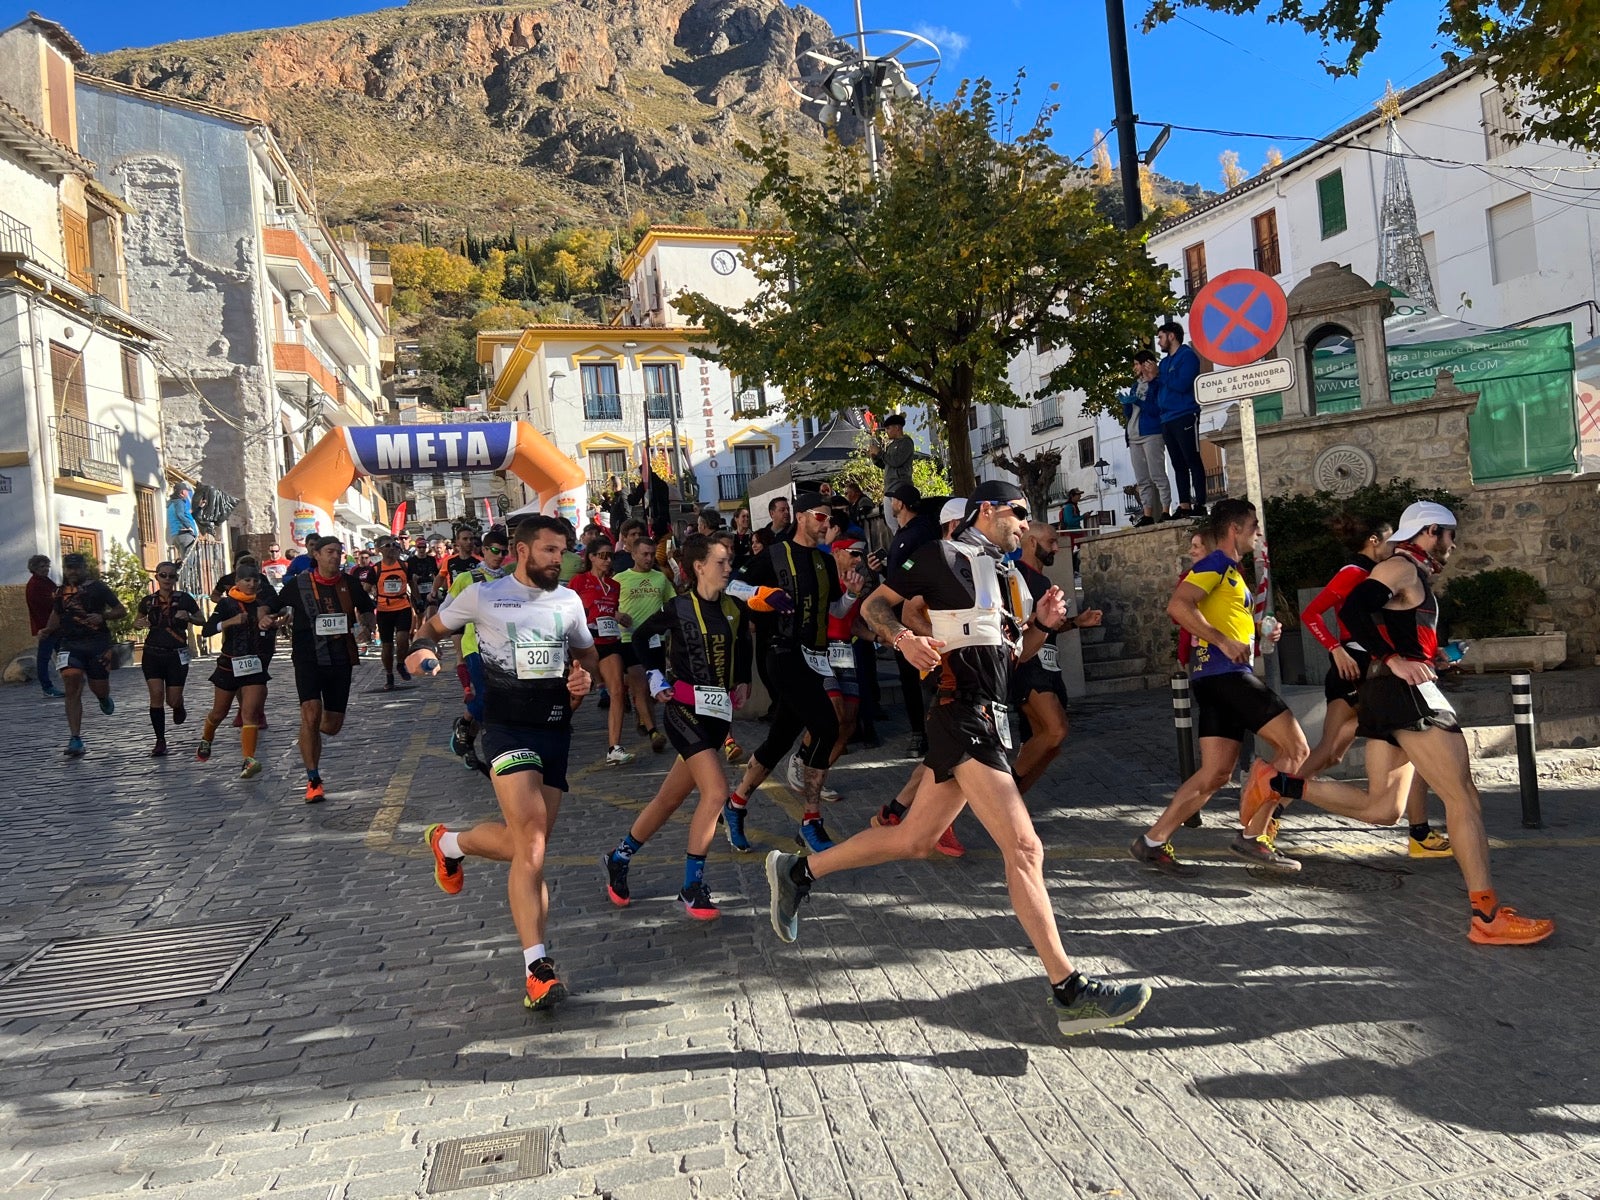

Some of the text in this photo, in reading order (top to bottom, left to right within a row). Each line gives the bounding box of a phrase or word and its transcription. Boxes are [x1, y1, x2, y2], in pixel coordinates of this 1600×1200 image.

[1423, 346, 1464, 359] alcance
[1201, 379, 1223, 389] ZONA
[1242, 367, 1285, 380] MANIOBRA
[1232, 378, 1271, 390] AUTOBUS
[376, 432, 491, 470] META
[322, 618, 337, 628] 301
[527, 650, 549, 665] 320
[238, 660, 253, 669] 218
[704, 693, 722, 706] 222
